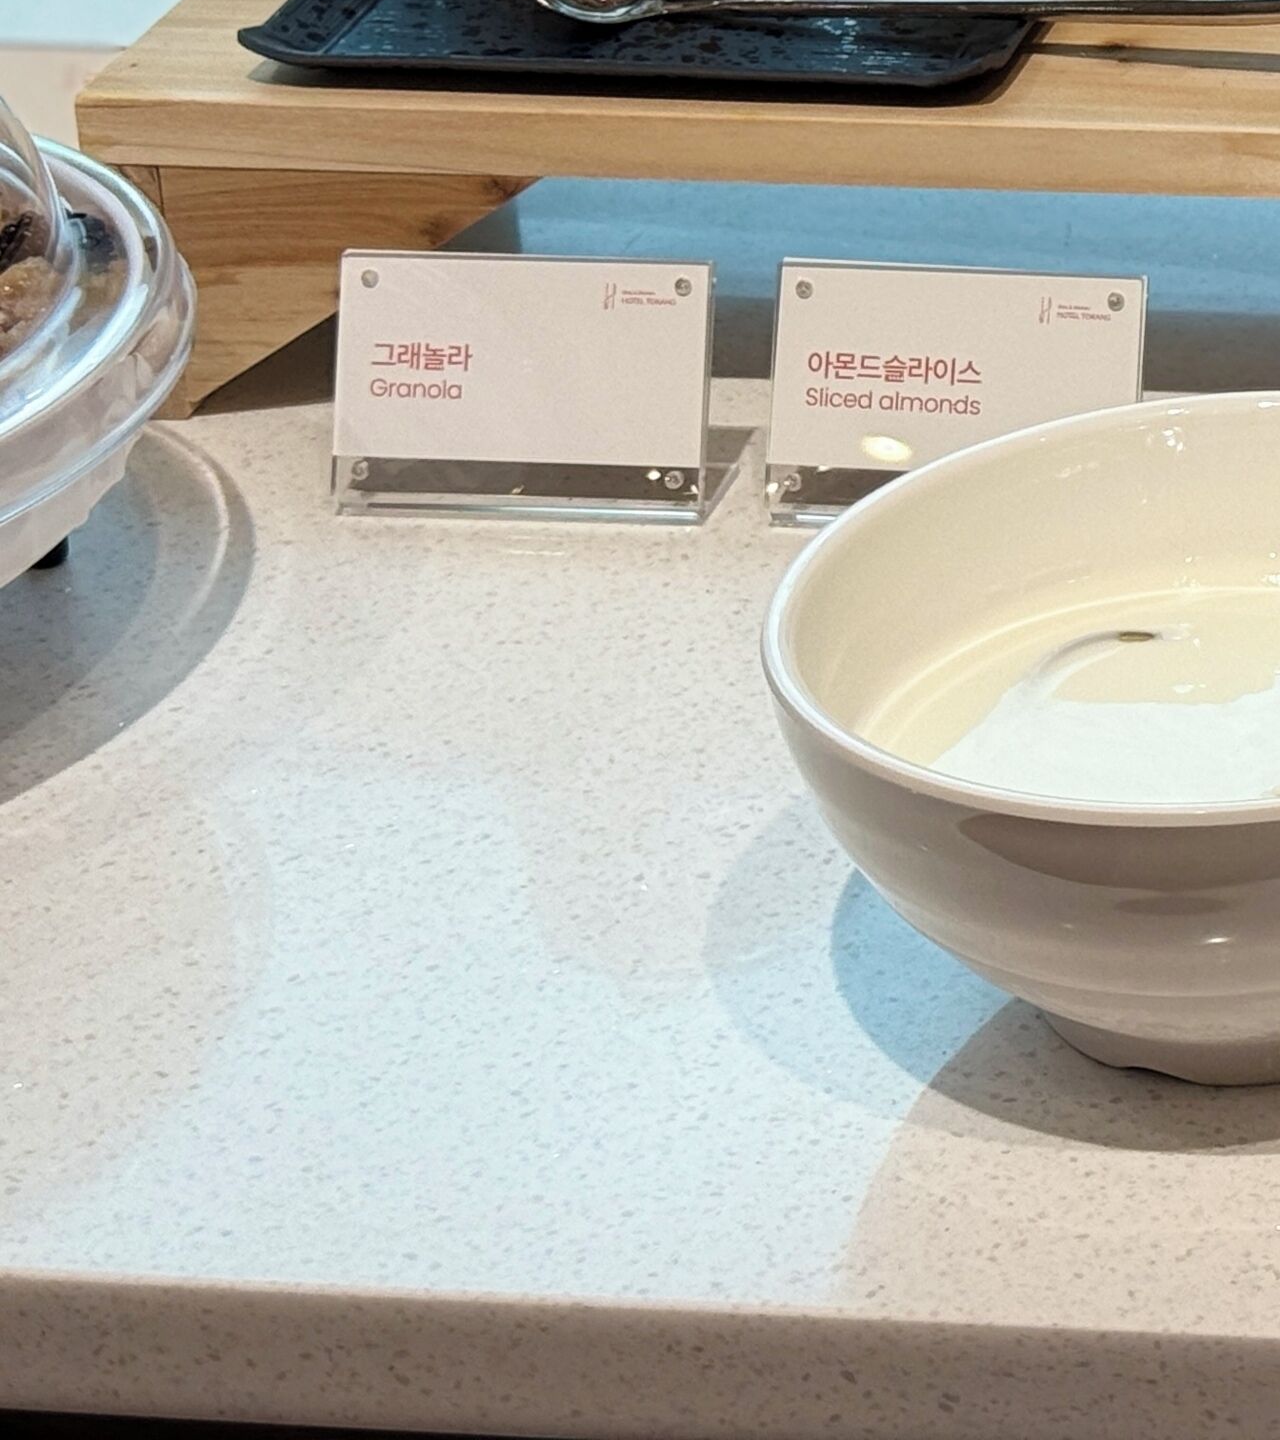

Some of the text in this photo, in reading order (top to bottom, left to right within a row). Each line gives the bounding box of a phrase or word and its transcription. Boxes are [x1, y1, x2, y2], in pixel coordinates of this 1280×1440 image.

[371, 342, 473, 371] 그래놀라
[807, 351, 982, 386] 아몬드슬라이스
[370, 378, 462, 399] Granola
[805, 387, 981, 415] Sliced almonds
